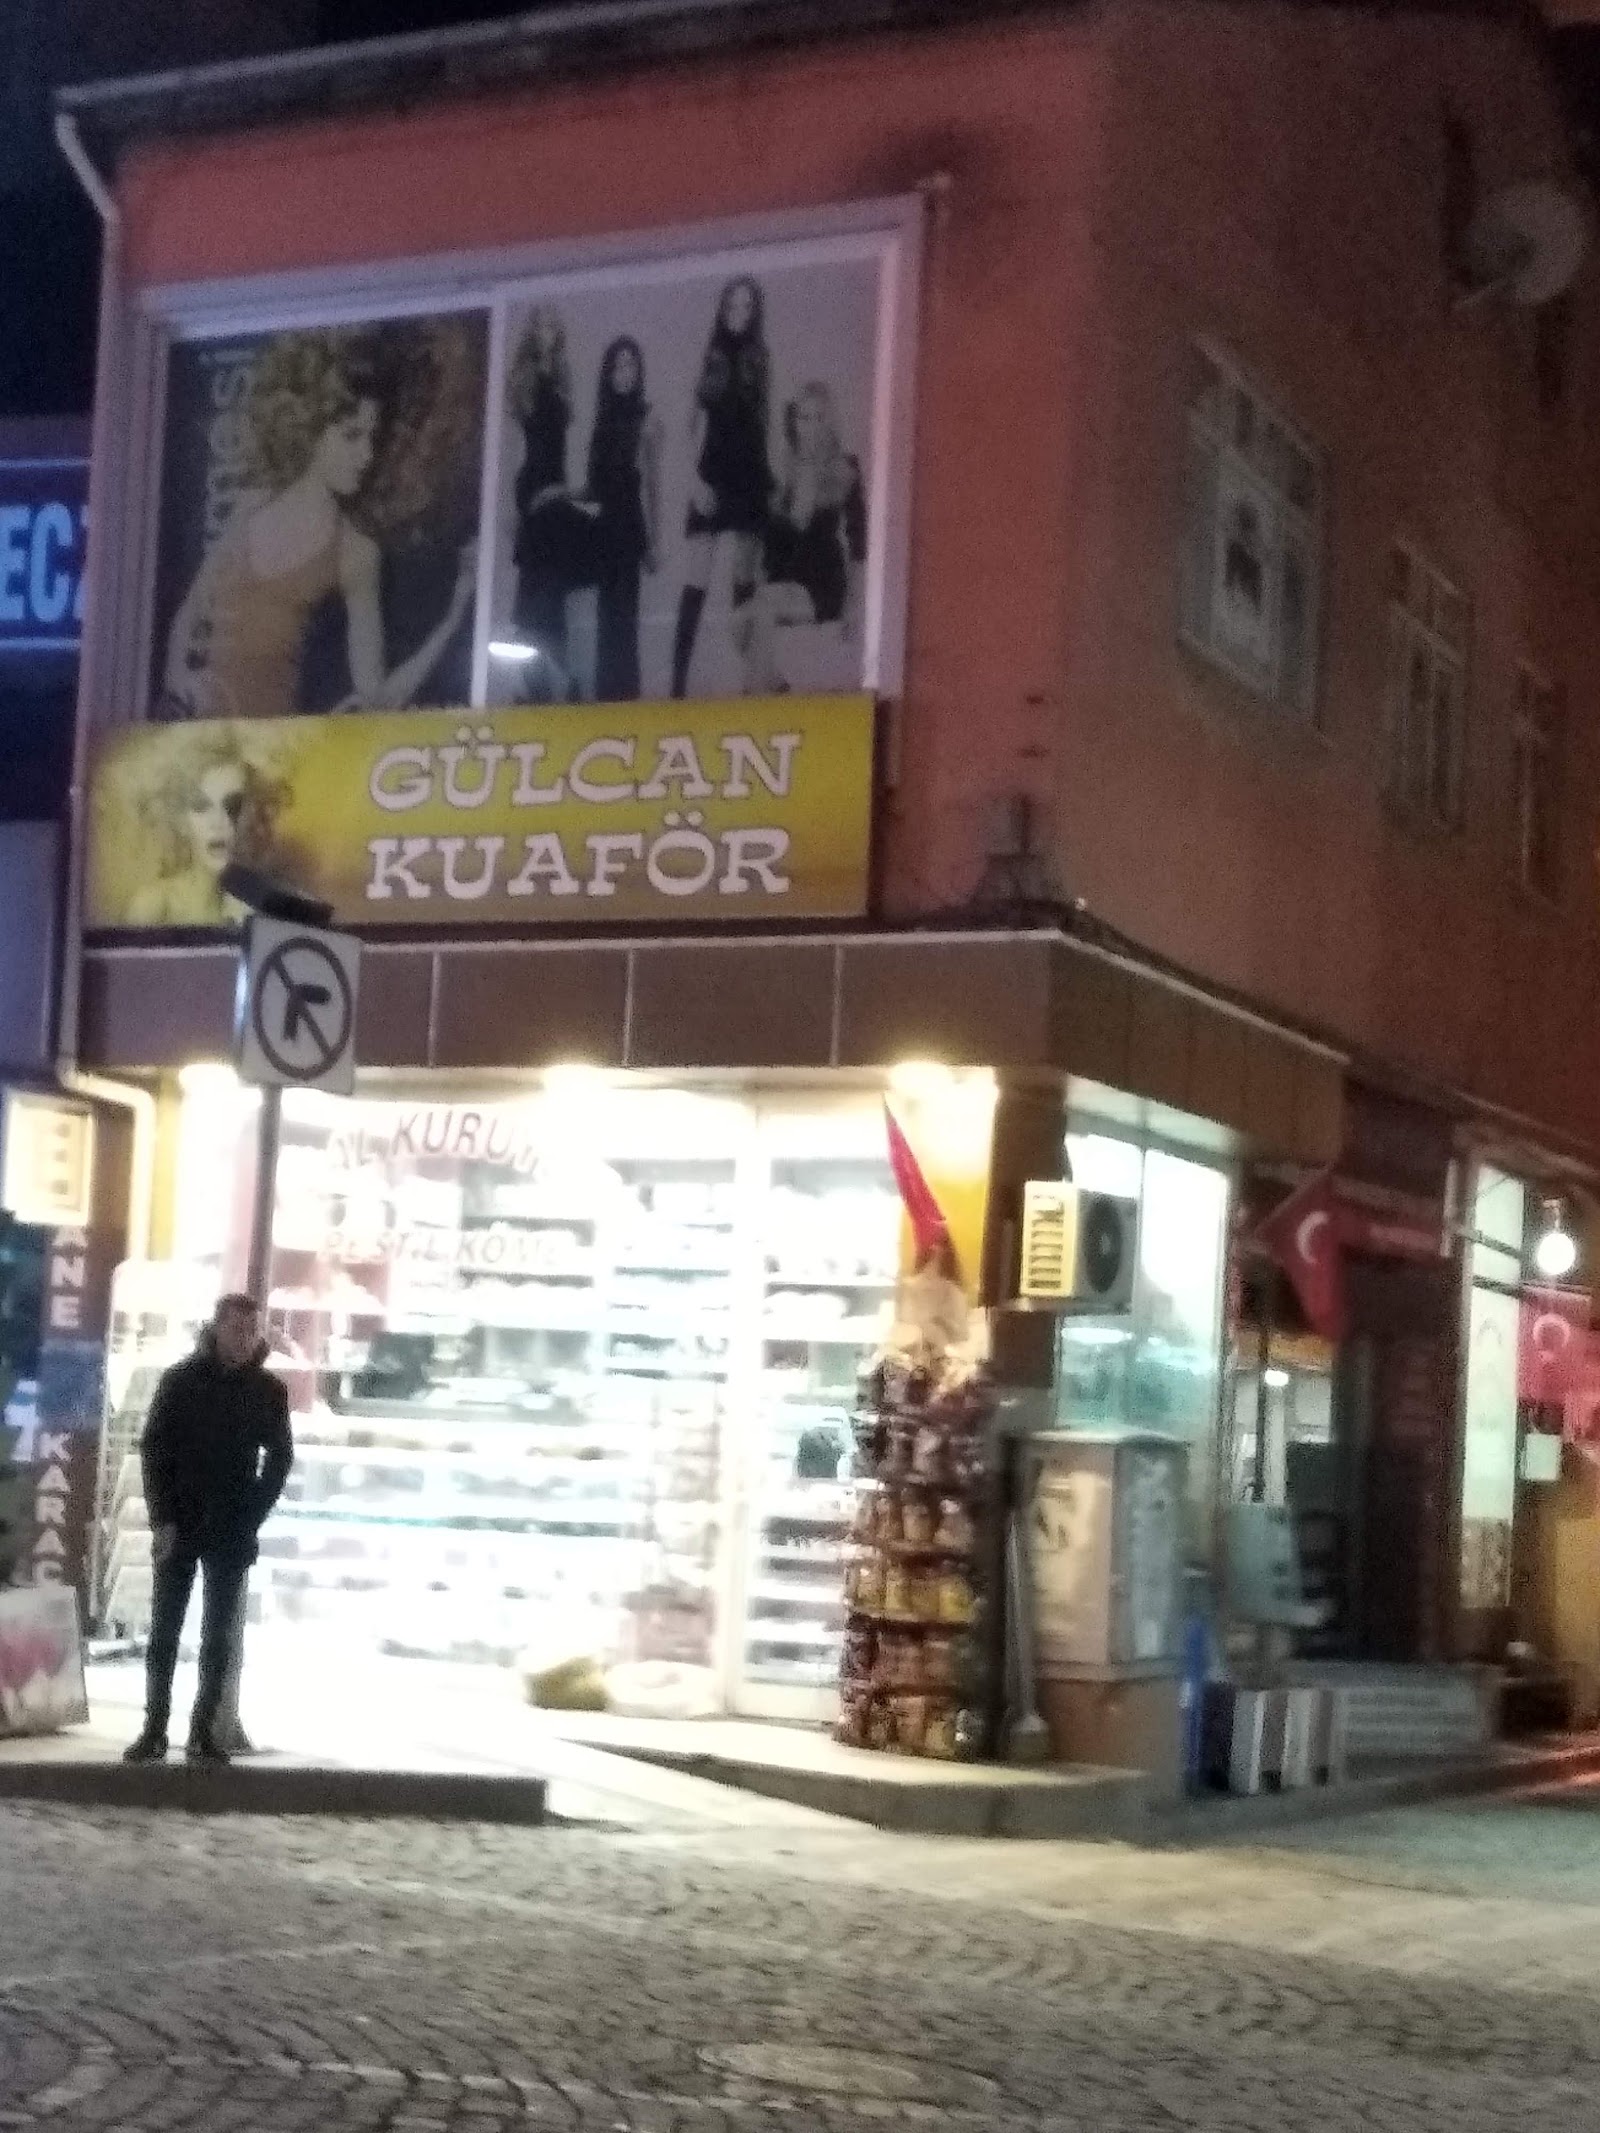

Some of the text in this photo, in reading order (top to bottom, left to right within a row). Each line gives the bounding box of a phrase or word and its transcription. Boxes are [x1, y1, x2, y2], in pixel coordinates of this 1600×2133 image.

[0, 503, 88, 622] EC
[369, 726, 801, 811] GÜLCAN
[366, 810, 791, 900] KUAFÖR
